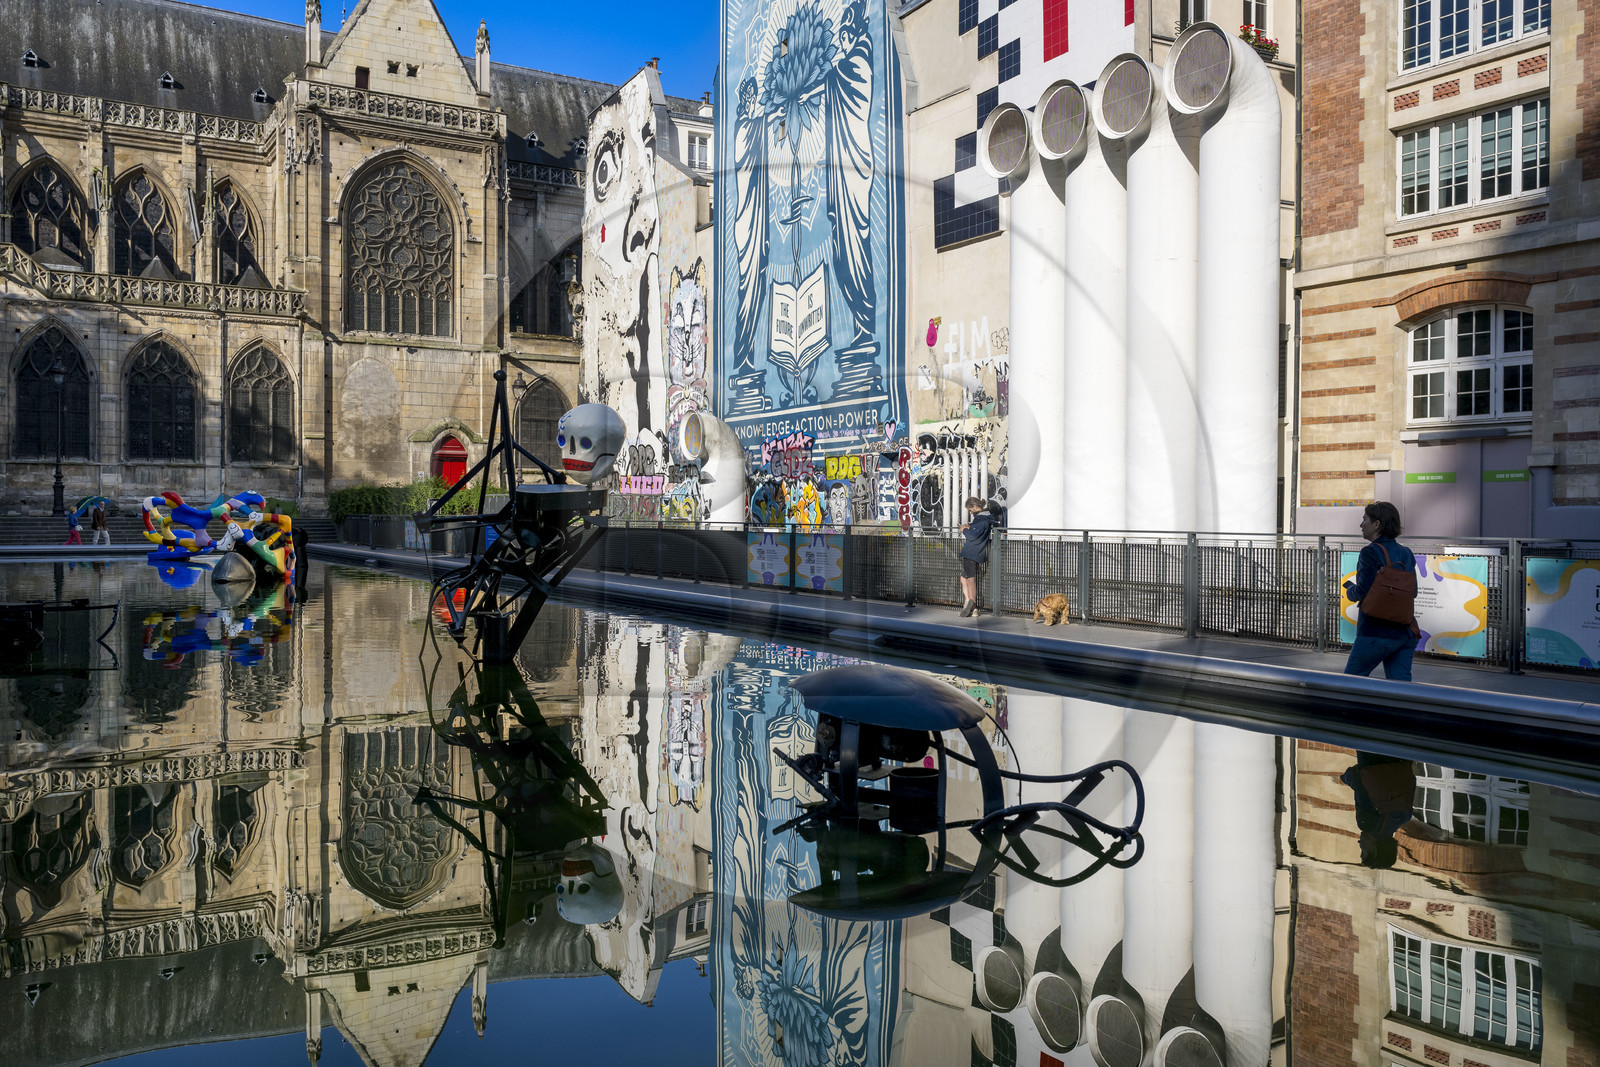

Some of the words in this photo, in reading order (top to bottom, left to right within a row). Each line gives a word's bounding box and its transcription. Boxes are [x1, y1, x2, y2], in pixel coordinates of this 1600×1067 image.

[780, 302, 789, 318] THE
[776, 318, 793, 340] FUTURE
[620, 475, 664, 494] LOCO
